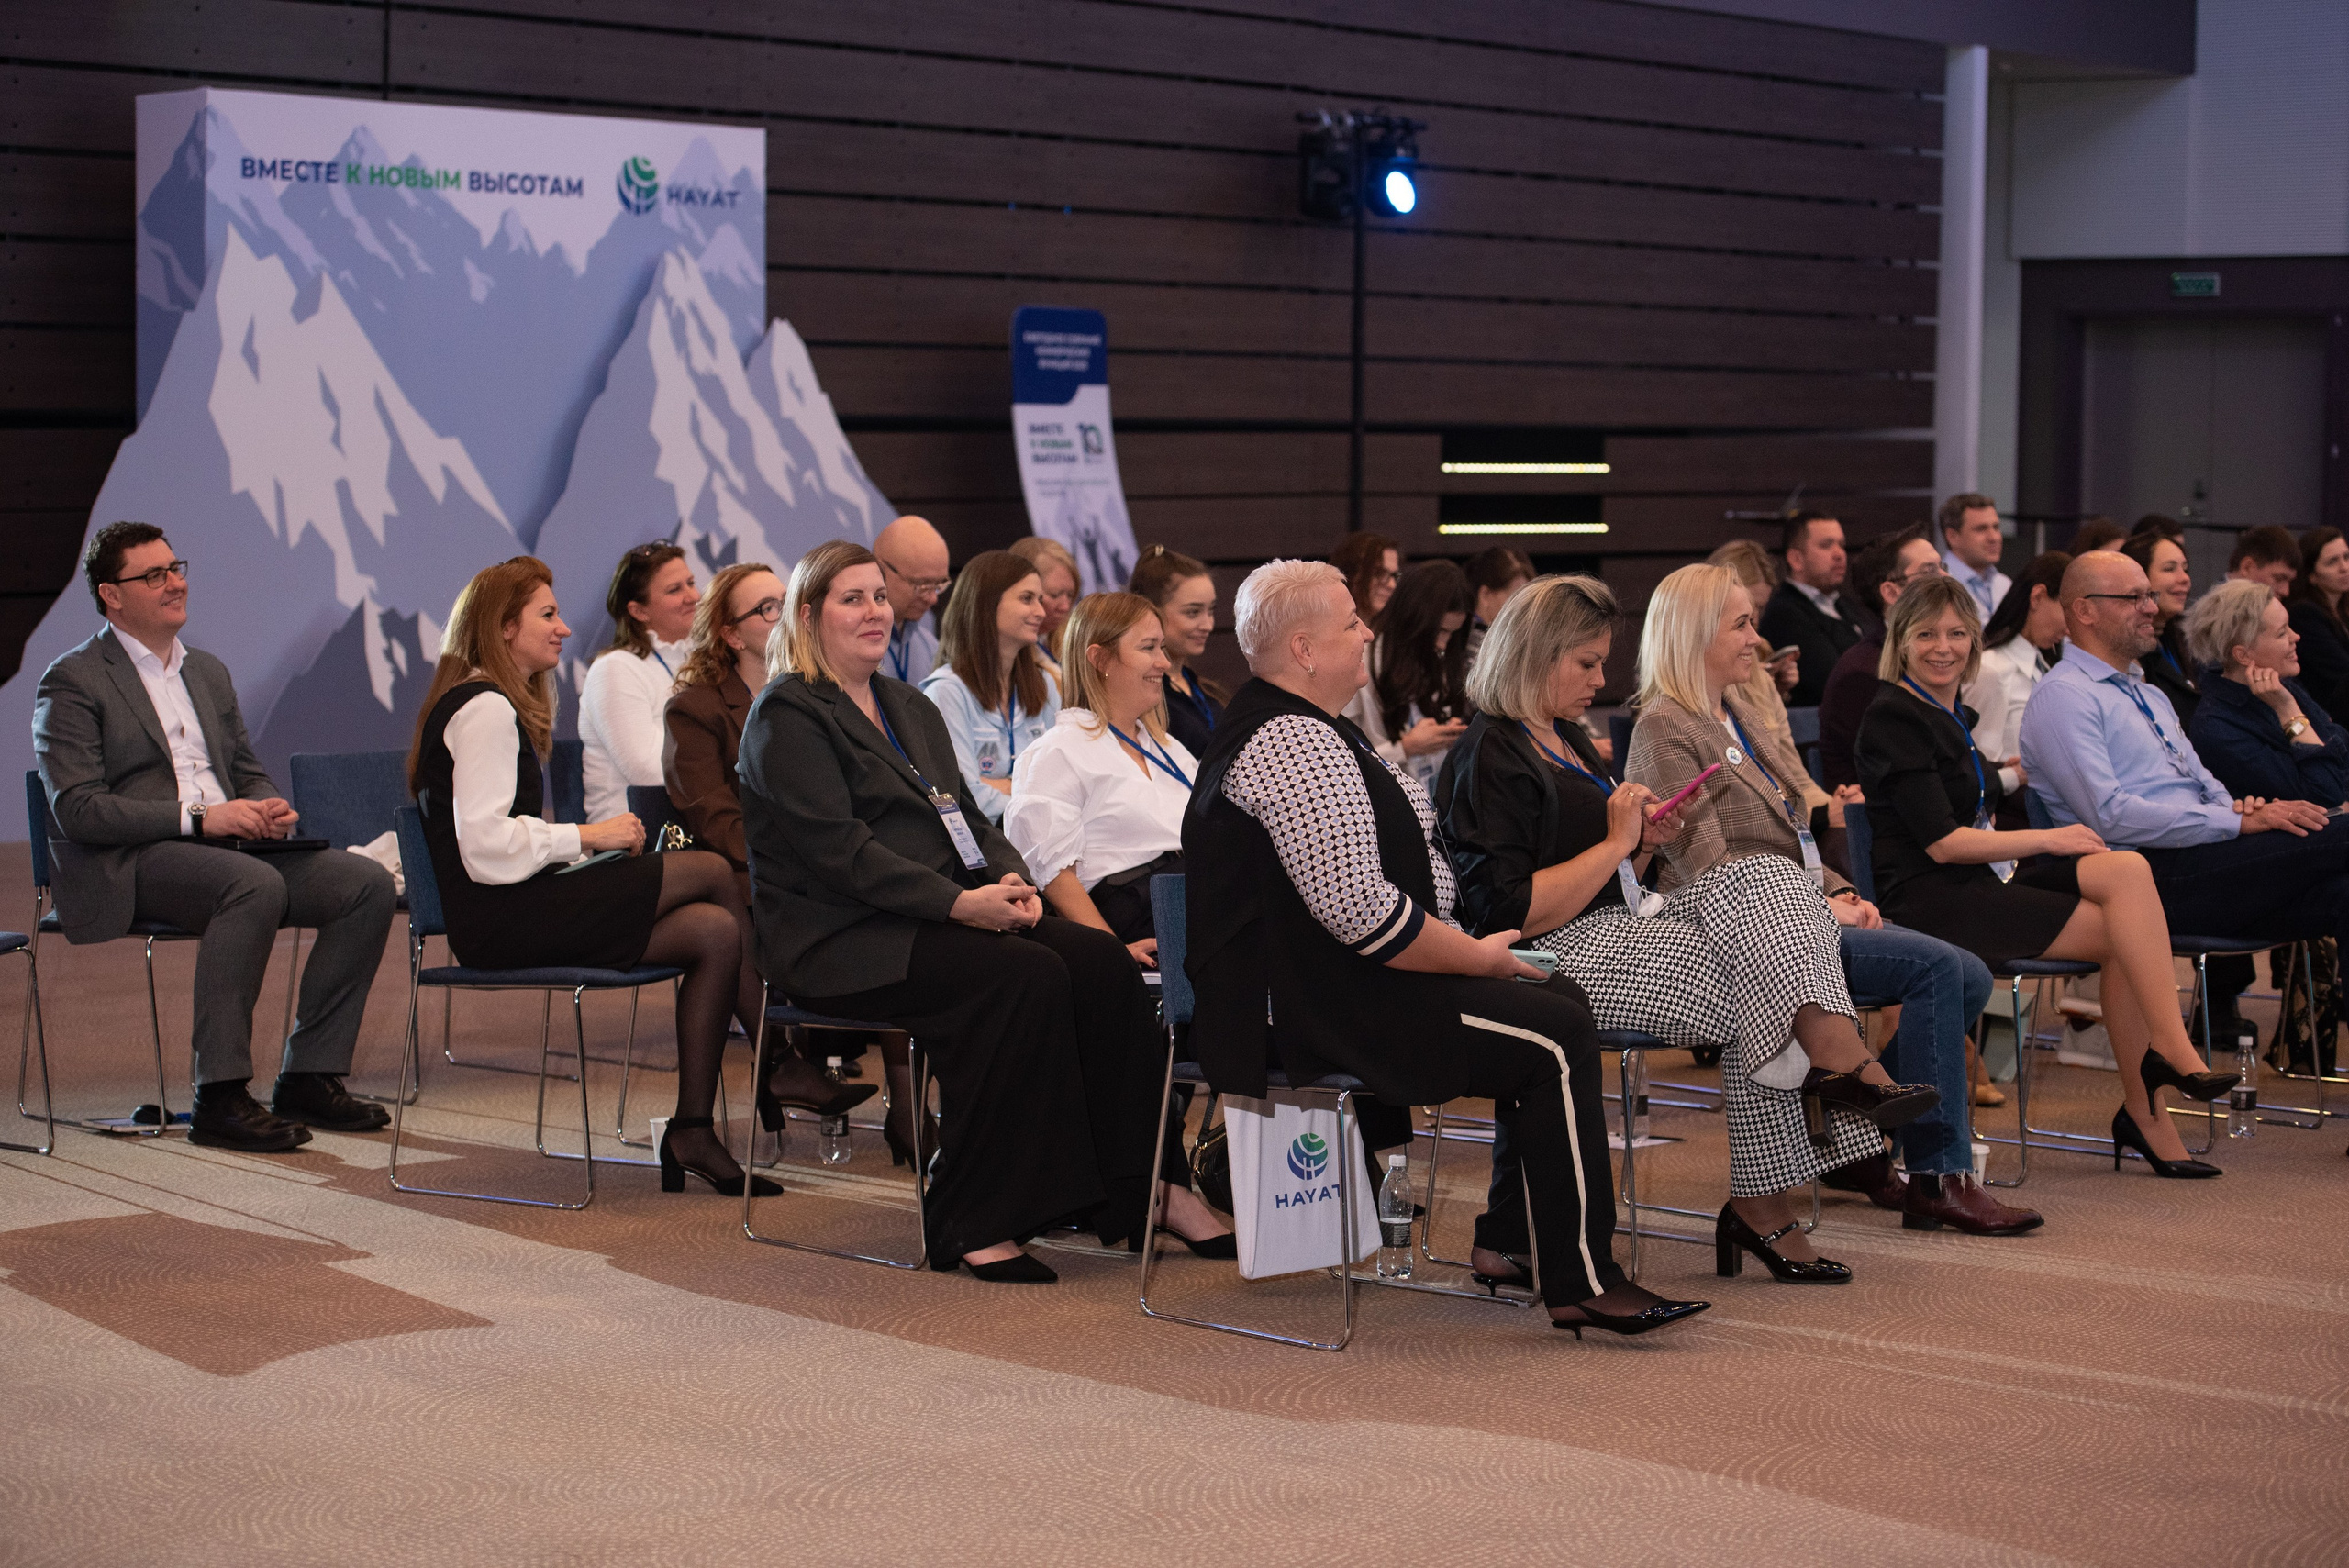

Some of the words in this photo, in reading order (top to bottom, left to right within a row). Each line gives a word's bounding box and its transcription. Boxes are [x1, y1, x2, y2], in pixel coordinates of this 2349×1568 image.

[240, 157, 339, 183] ВМЕСТЕ
[346, 163, 362, 184] К
[369, 165, 461, 190] НОВЫМ
[469, 171, 584, 197] ВЫСОТАМ
[665, 185, 740, 208] HAYAT
[1275, 1184, 1341, 1209] HAYAT
